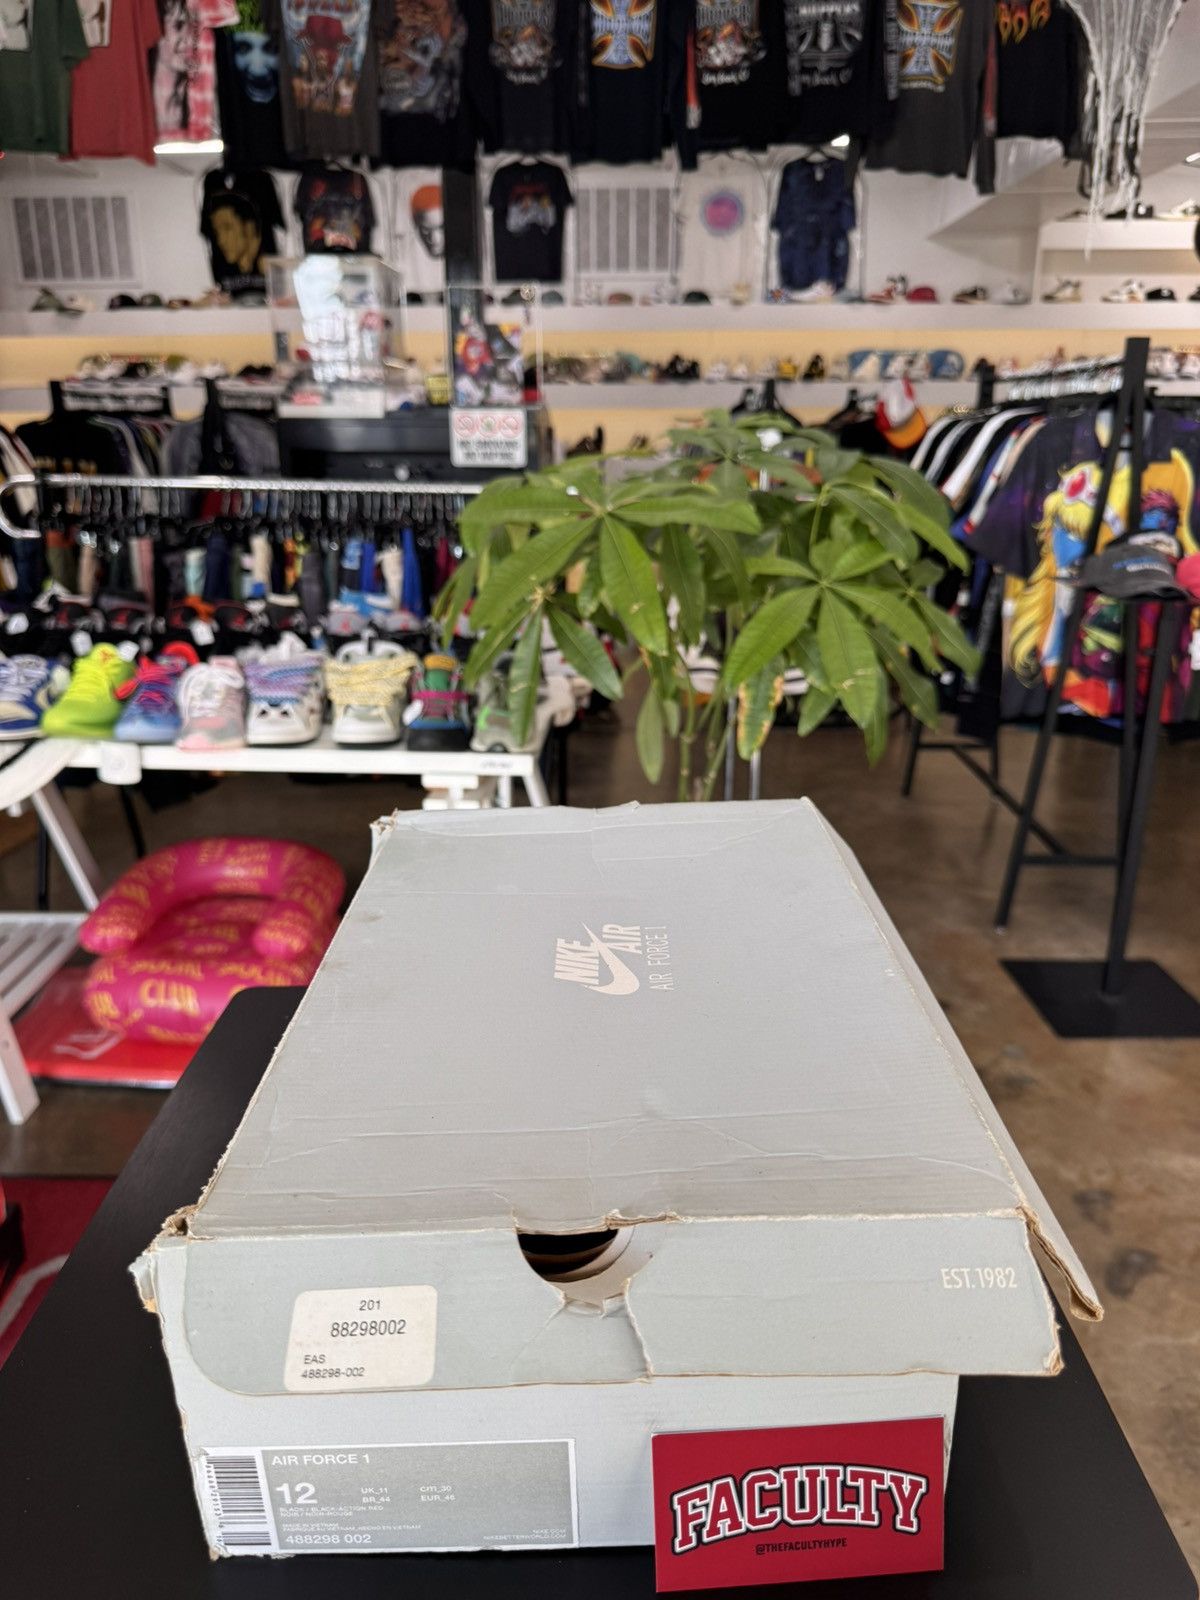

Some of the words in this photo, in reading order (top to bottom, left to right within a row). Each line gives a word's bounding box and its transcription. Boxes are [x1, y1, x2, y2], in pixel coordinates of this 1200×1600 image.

[553, 938, 600, 985] NIKE
[602, 923, 643, 955] AIR
[645, 934, 672, 966] FORCE
[648, 972, 675, 992] AIR
[359, 1299, 382, 1311] 201
[330, 1319, 407, 1338] 88298002
[304, 1354, 326, 1365] EAS
[301, 1366, 366, 1379] 488298-002
[272, 1455, 299, 1465] AIR
[303, 1454, 359, 1465] FORCE
[362, 1453, 370, 1464] 1
[275, 1482, 318, 1504] 12
[672, 1463, 929, 1555] FACULTY
[284, 1535, 340, 1544] 488298
[344, 1534, 372, 1543] 002
[755, 1537, 848, 1555] @THEFACULTYHYPE
